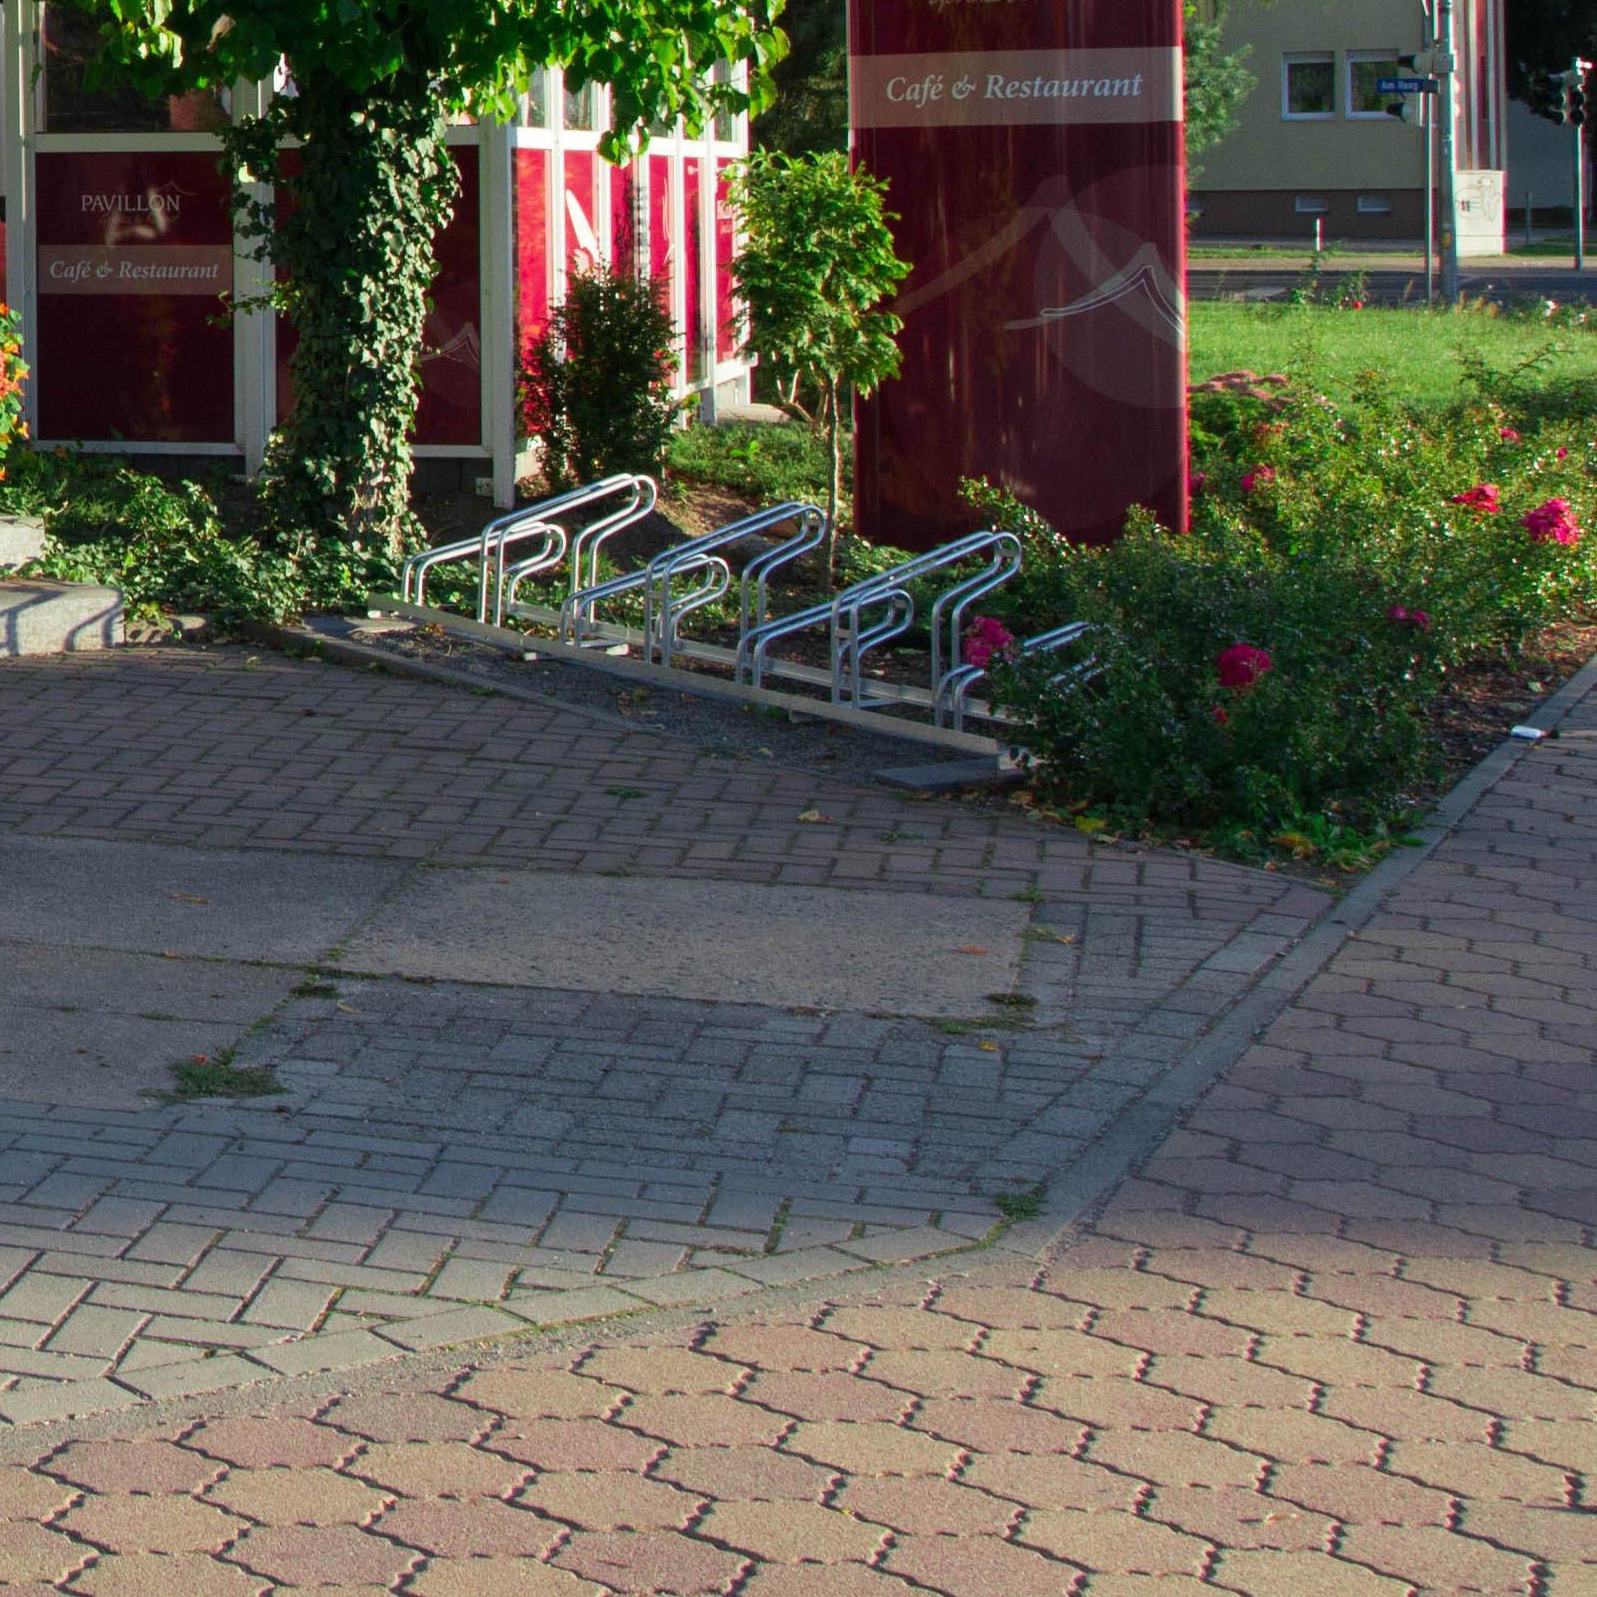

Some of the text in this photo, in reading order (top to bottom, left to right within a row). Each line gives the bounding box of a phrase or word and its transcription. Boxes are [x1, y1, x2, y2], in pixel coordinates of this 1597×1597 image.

[886, 73, 1144, 108] Café & Restaurant
[81, 194, 181, 212] PAVILLON
[49, 260, 219, 283] Café & Restaurant
